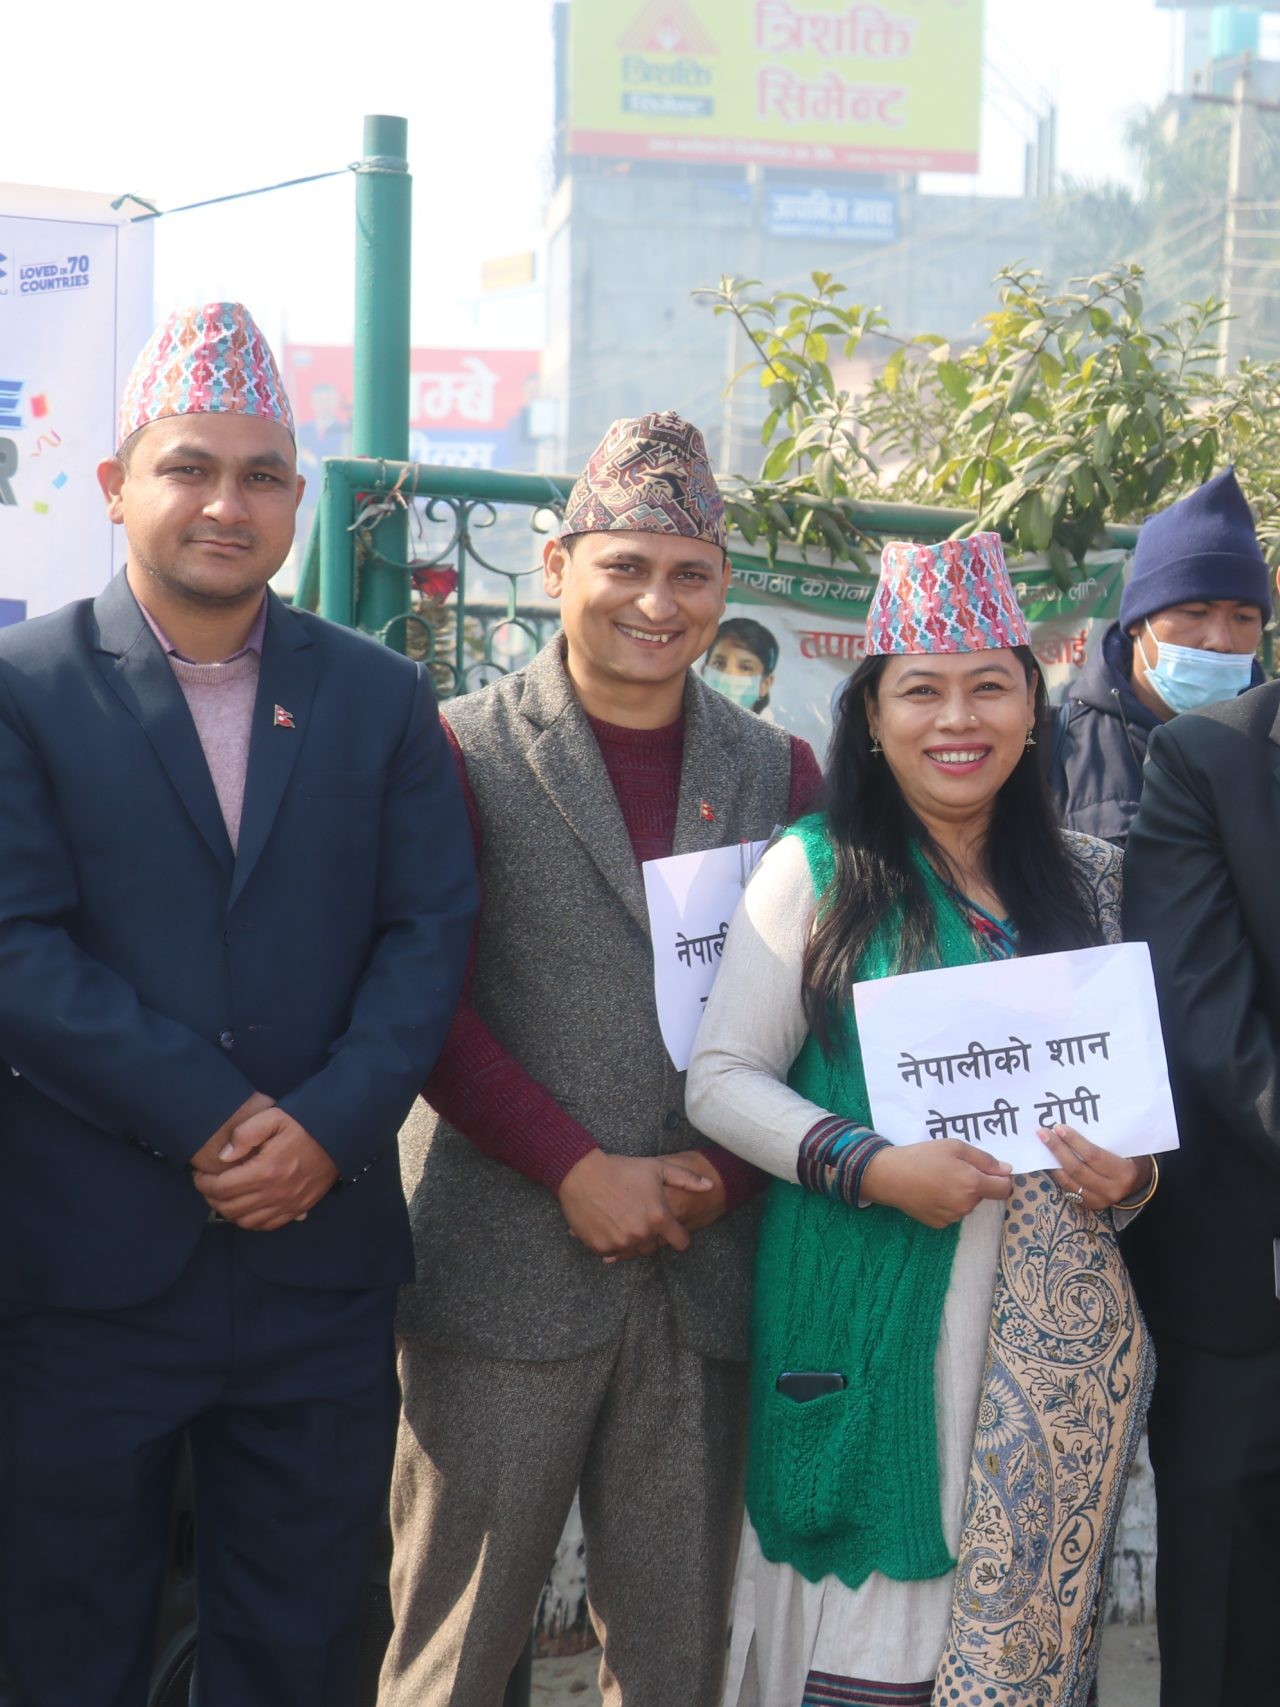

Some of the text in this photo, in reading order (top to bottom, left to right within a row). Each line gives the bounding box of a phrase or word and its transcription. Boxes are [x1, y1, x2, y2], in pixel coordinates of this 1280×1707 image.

[759, 67, 907, 126] सिमेन्ट
[20, 265, 58, 279] LOVED
[67, 255, 89, 275] 70
[20, 274, 89, 293] COUNTRIES
[800, 574, 872, 602] कोरोना
[897, 1031, 1110, 1088] नेपालीको शान
[926, 1086, 1102, 1140] नेपाली टोपी
